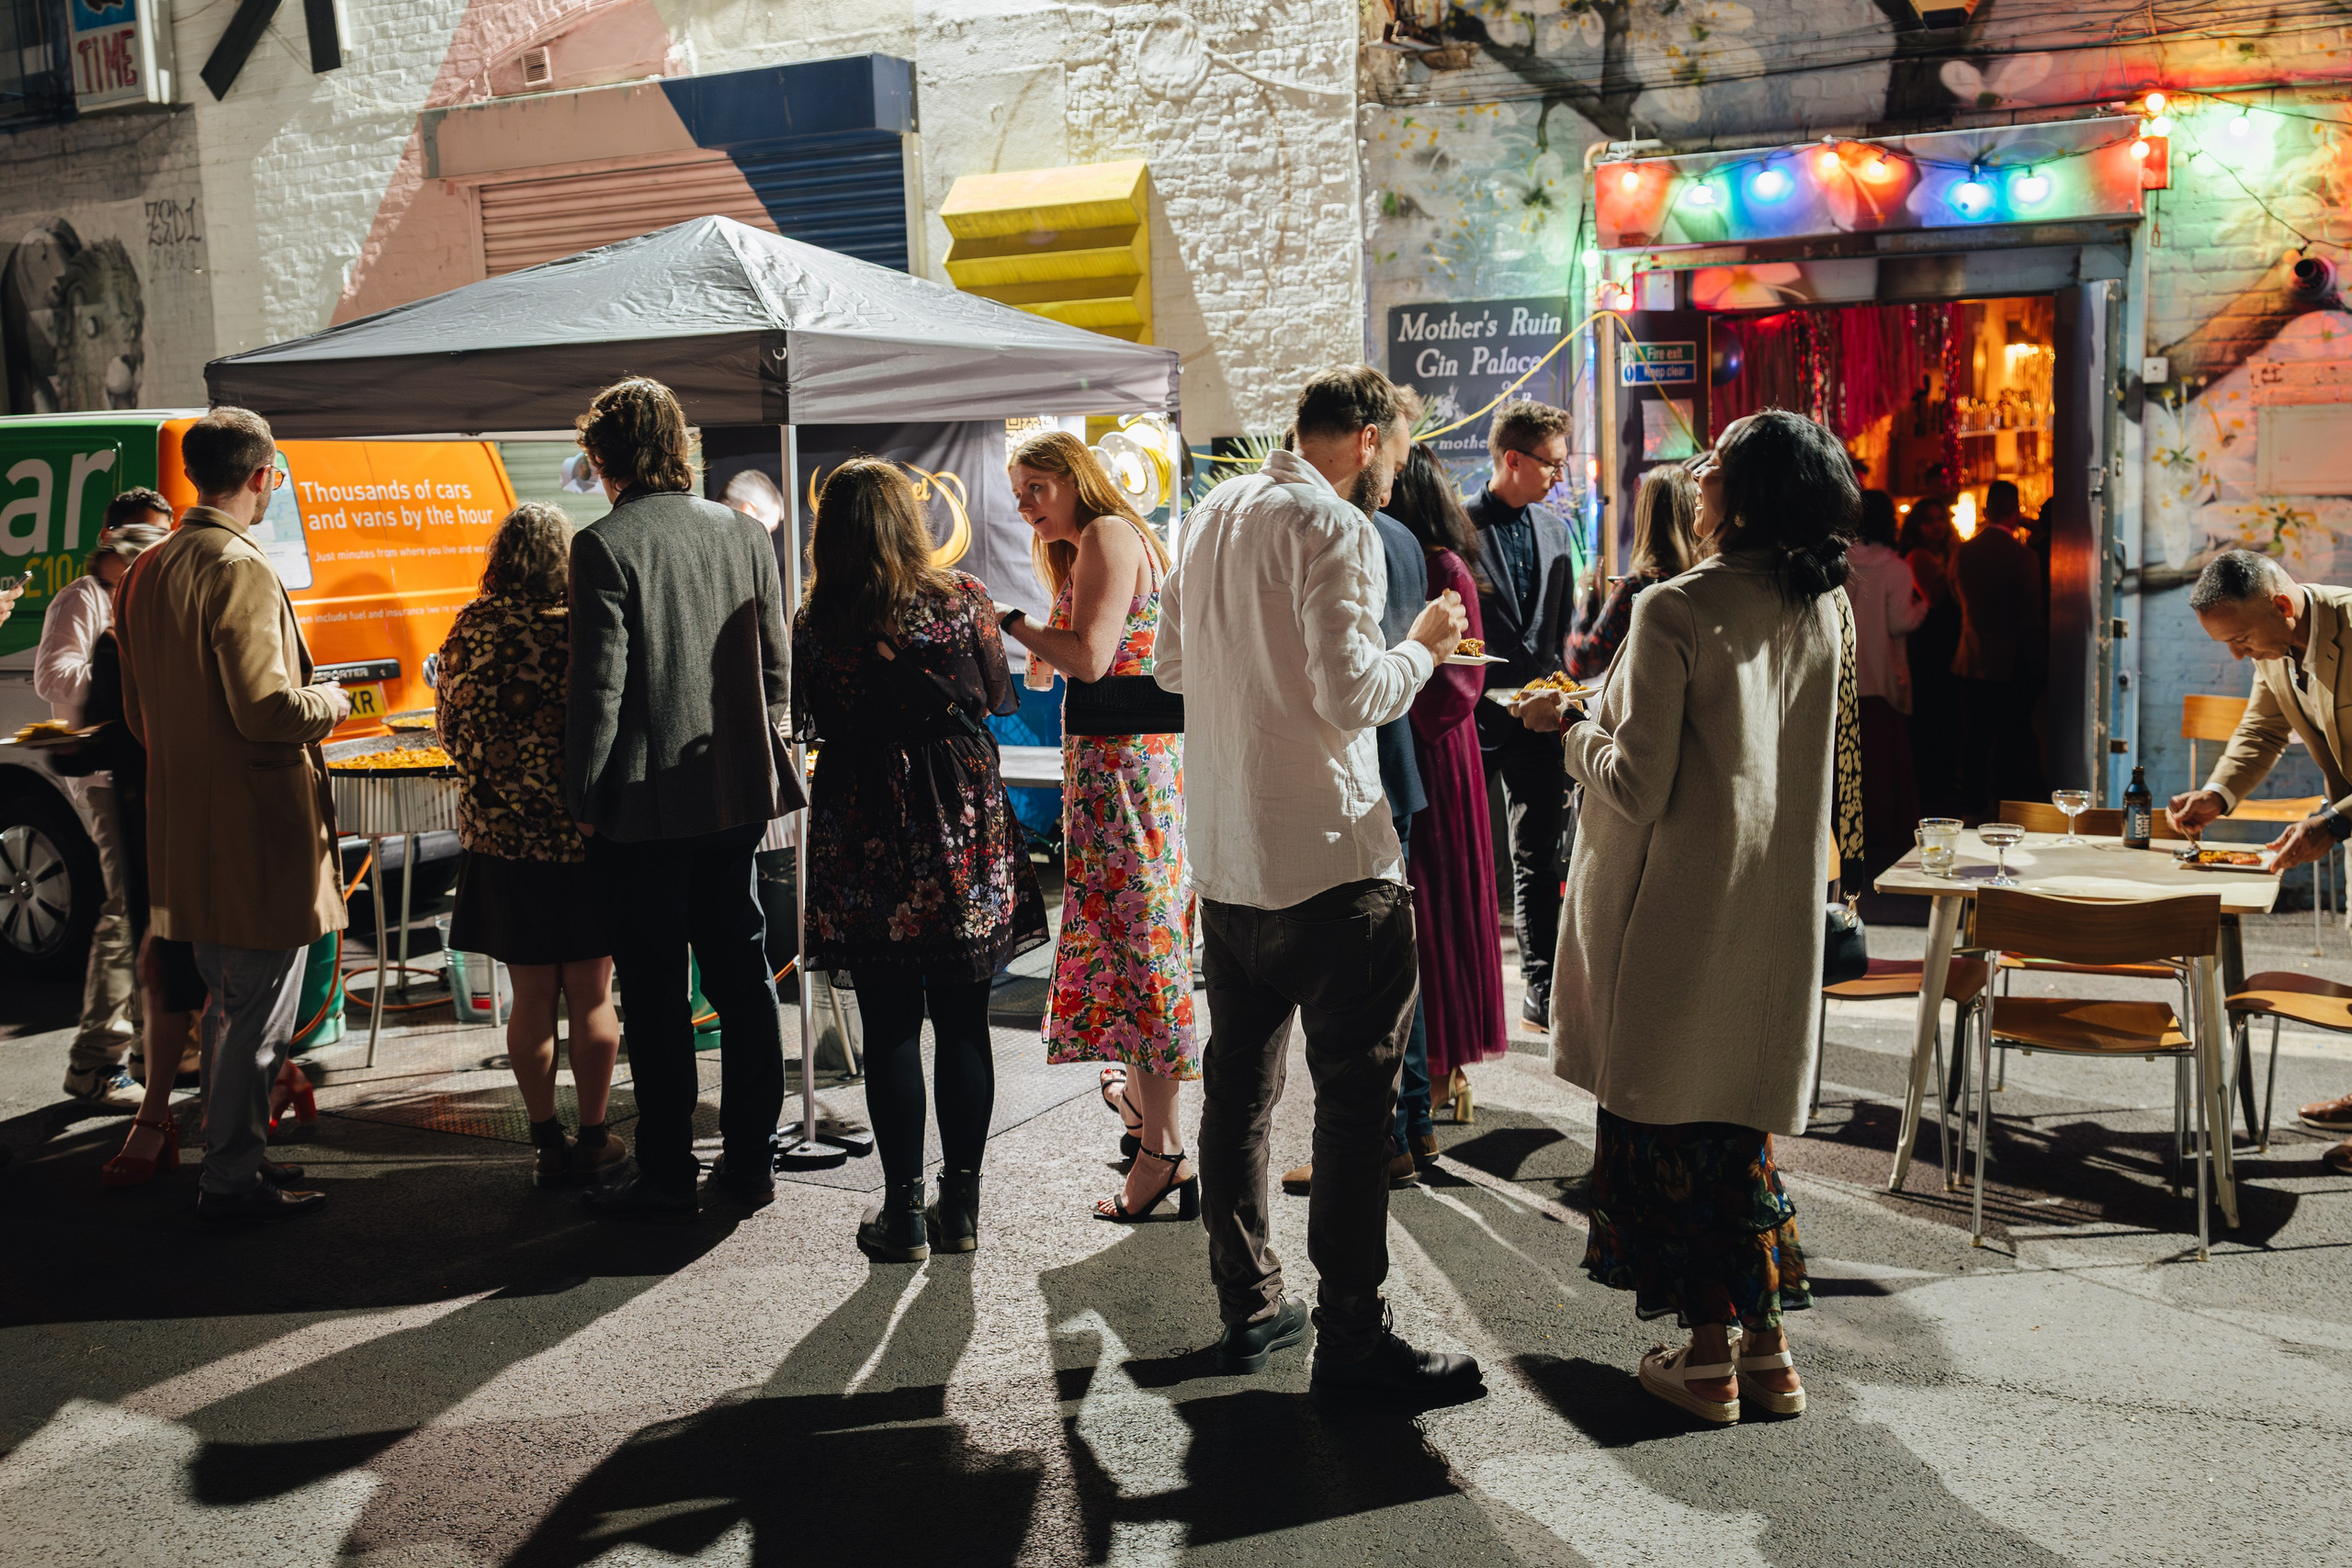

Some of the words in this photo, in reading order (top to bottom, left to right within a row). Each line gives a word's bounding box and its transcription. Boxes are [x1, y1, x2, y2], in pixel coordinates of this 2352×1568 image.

[77, 28, 137, 93] TIME
[1396, 310, 1498, 343] Mother's
[1508, 306, 1562, 337] Ruin
[1416, 348, 1459, 378] Gin
[1468, 345, 1544, 376] Palace
[1646, 345, 1666, 360] Fire
[1667, 346, 1683, 359] exit
[1644, 366, 1665, 379] Kep
[1667, 364, 1687, 378] clear
[1438, 434, 1489, 451] mothe
[299, 479, 411, 502] Thousands
[414, 479, 432, 499] of
[435, 483, 472, 499] cars
[911, 477, 932, 502] et
[0, 448, 117, 558] ar
[308, 507, 347, 530] and
[351, 511, 397, 528] vans
[401, 505, 423, 531] by
[425, 504, 455, 525] the
[457, 503, 493, 525] hour
[314, 550, 335, 562] Just
[337, 546, 375, 560] minutes
[377, 543, 397, 557] from
[400, 545, 425, 556] where
[427, 544, 441, 556] you
[442, 545, 456, 554] live
[458, 544, 472, 553] and
[473, 544, 491, 554] wor
[298, 615, 312, 625] ven
[314, 612, 347, 624] include
[349, 611, 366, 621] fuel
[368, 609, 383, 620] and
[385, 605, 424, 619] insurance
[314, 667, 369, 682] SPORTER
